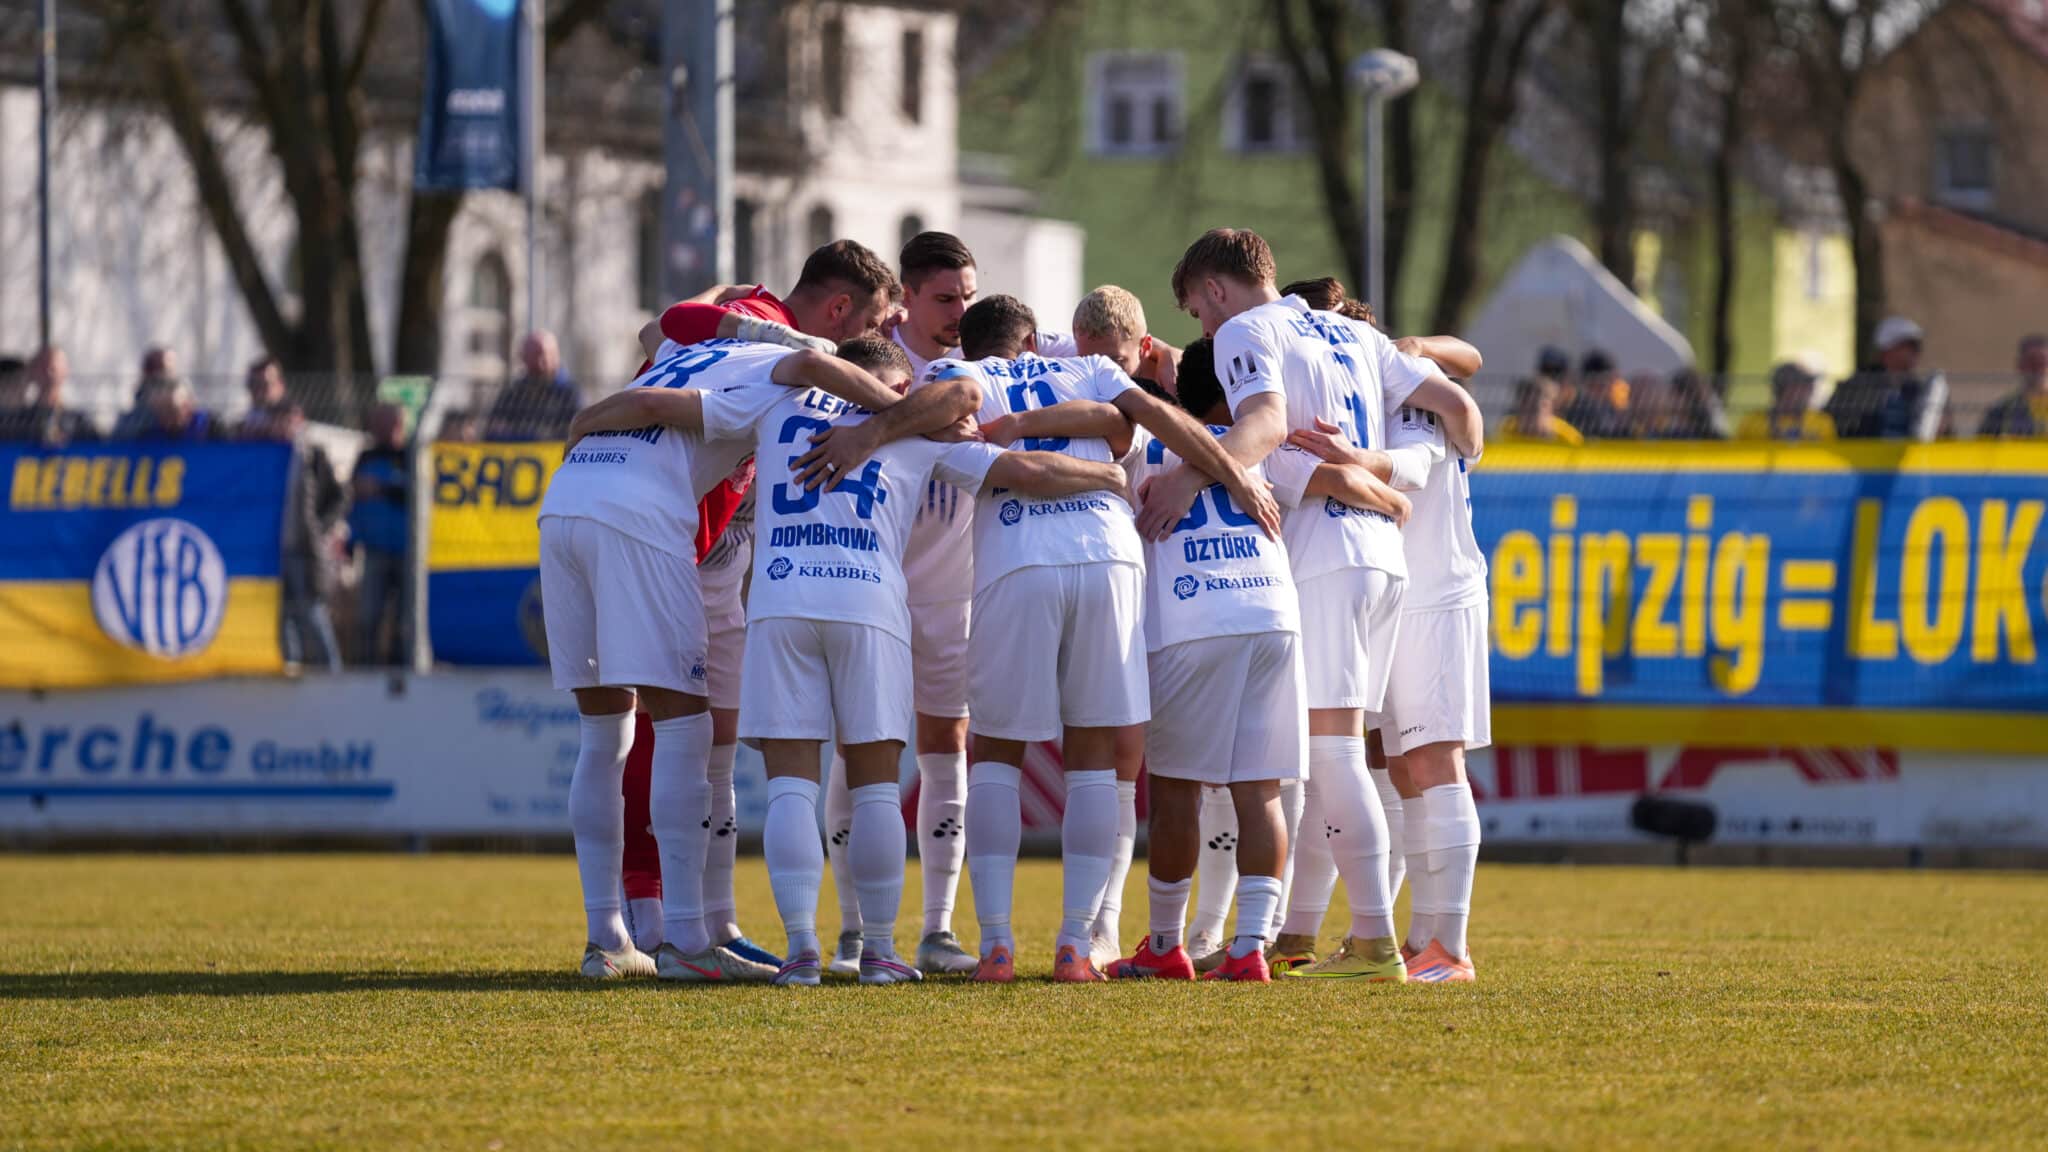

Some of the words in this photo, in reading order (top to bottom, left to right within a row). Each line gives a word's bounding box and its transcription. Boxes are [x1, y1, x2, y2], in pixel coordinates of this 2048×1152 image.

[804, 390, 878, 415] LEIPZ
[569, 452, 628, 465] KRABBES
[772, 415, 887, 520] 34
[10, 456, 187, 511] REBELLS
[433, 454, 545, 508] BAD
[1028, 500, 1110, 516] KRABBES
[770, 523, 880, 552] DOMBROWA
[1184, 533, 1260, 563] ÖZTÜRK
[798, 566, 881, 583] KRABBES
[1205, 576, 1284, 591] KRABBES
[1490, 494, 1771, 697] eipzig
[1778, 559, 1836, 629] =
[250, 741, 374, 777] GmbH
